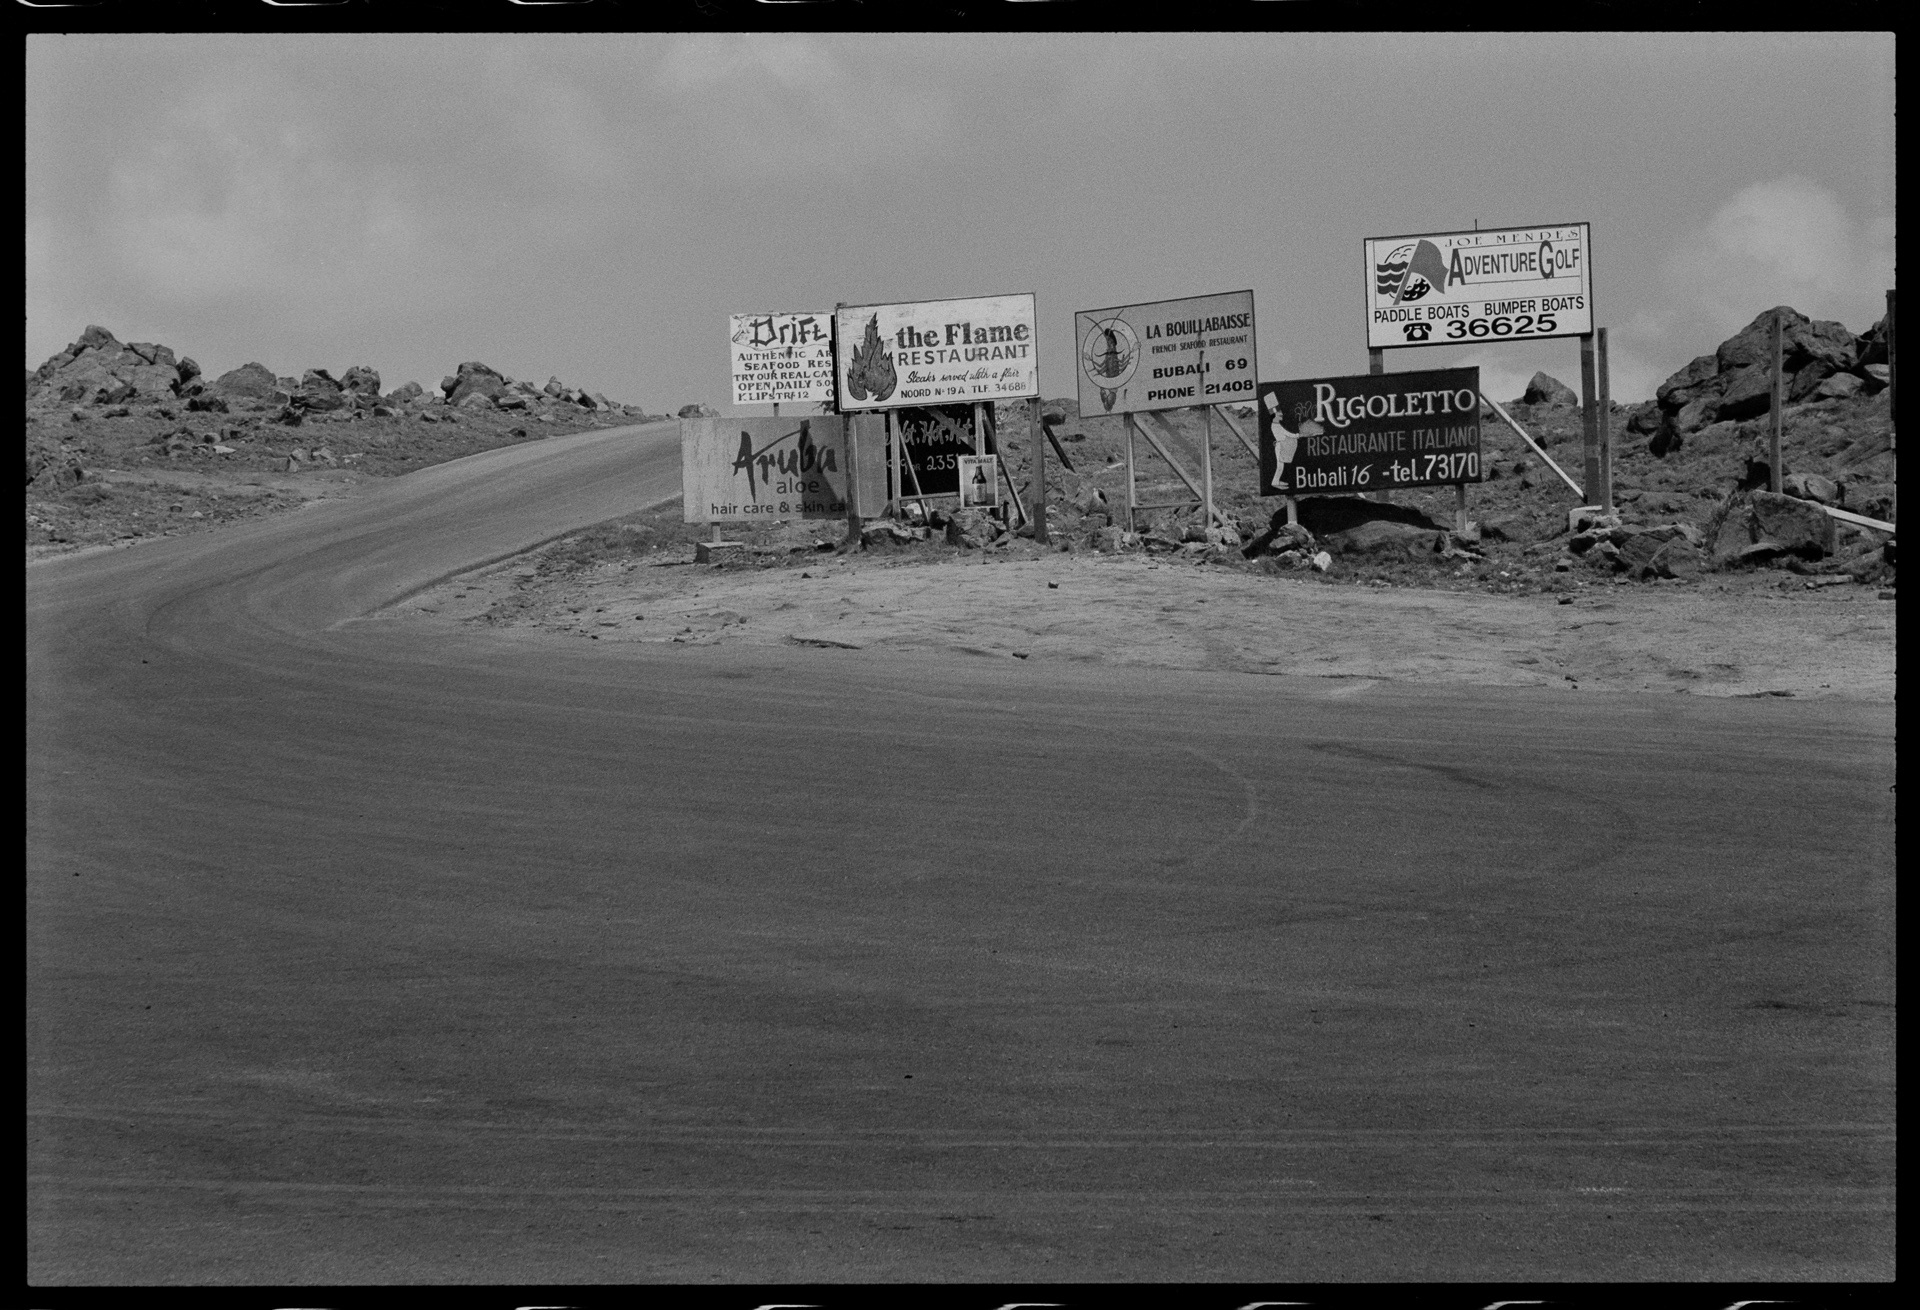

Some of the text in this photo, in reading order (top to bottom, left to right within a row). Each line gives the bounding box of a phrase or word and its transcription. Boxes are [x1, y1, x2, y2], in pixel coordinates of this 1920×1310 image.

[1445, 230, 1579, 247] JOE MENDES
[1448, 240, 1580, 286] ADVENTURE GOLF
[1374, 296, 1584, 323] PADDLE BOATS BUMPER BOATS
[896, 322, 1030, 349] the Flame
[1146, 313, 1251, 339] LA BOUILLABAISSE
[1446, 313, 1557, 339] 36625
[1152, 335, 1248, 354] FRENCH SEAFOOD RESTAURANT
[738, 349, 806, 361] AUTHENIC
[898, 344, 1030, 366] RESTAURANT
[744, 360, 832, 371] SEAFOOD RES
[1153, 358, 1248, 379] BUBALI 69
[734, 374, 754, 382] TRY
[757, 371, 778, 381] OUR
[781, 371, 811, 380] REAL
[738, 382, 771, 391] OPEN
[776, 380, 811, 390] DAILY
[905, 371, 936, 384] Steaks
[939, 370, 969, 383] served
[969, 367, 990, 380] with
[1000, 367, 1020, 385] flair
[900, 389, 931, 398] NOORD
[1148, 380, 1254, 400] PHONE 21408
[1313, 383, 1476, 428] RIGOLETTO
[1307, 426, 1478, 456] RISTAURANTE ITALIANO
[732, 419, 838, 503] Aruba
[1295, 462, 1347, 488] Bubali
[1351, 464, 1374, 485] 16
[776, 477, 820, 494] aloe
[711, 503, 738, 514] hair
[743, 504, 774, 513] care
[779, 501, 790, 513] &
[796, 501, 824, 513] skin
